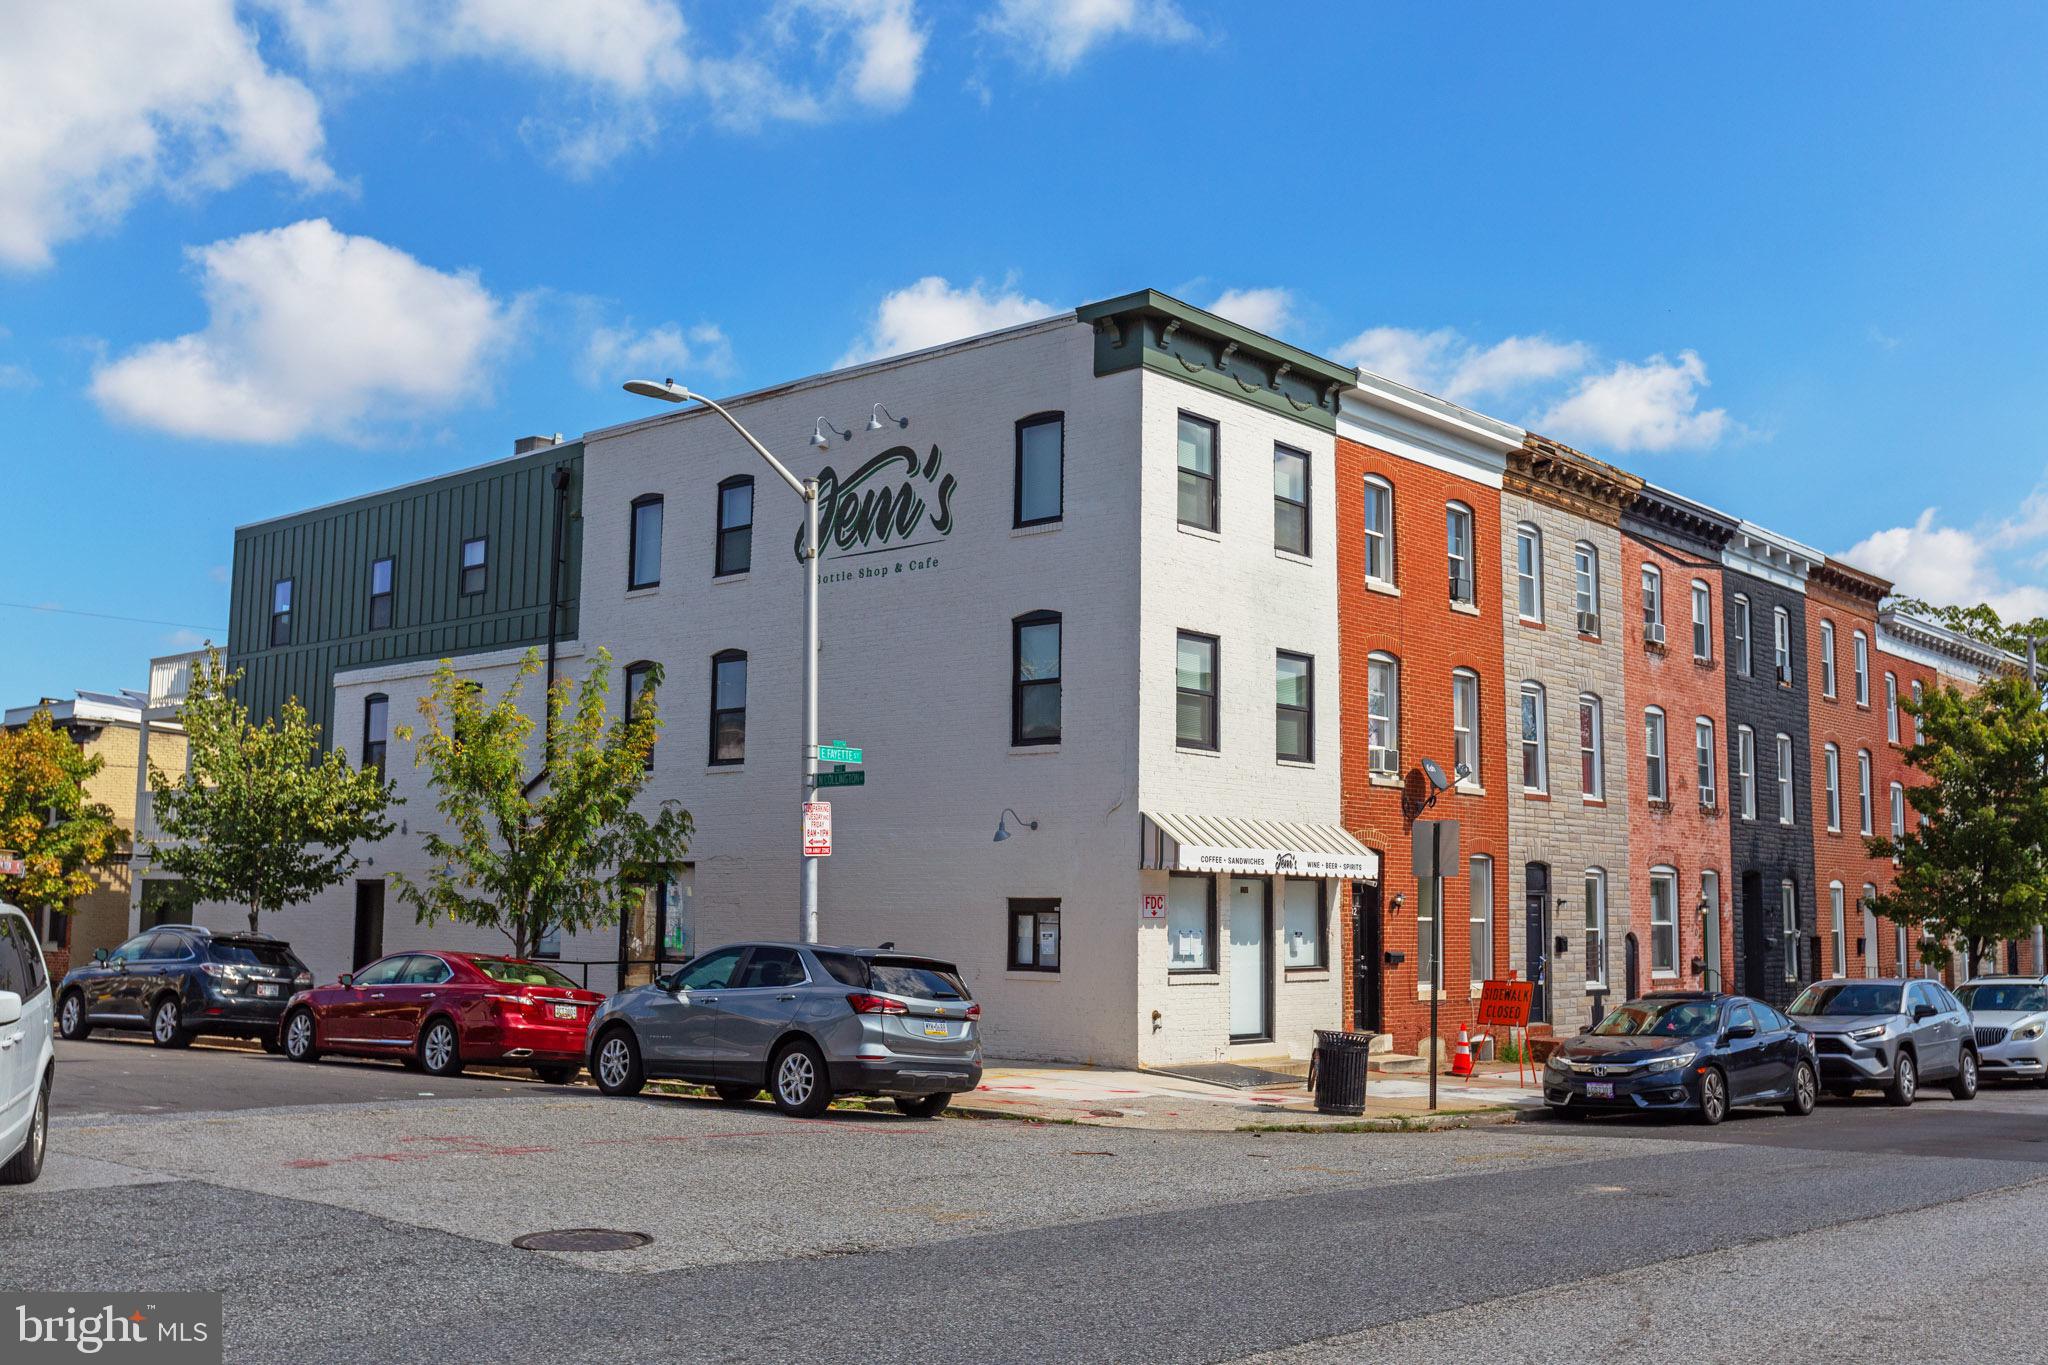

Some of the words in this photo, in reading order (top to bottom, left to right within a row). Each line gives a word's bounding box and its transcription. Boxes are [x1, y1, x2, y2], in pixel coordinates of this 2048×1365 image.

[858, 567, 888, 578] Shop
[894, 562, 903, 573] &
[909, 557, 939, 571] Cafe
[821, 748, 826, 759] E
[827, 748, 853, 761] FAYETTE
[1200, 855, 1223, 864] COFFEE
[1227, 857, 1265, 866] SANDWICHES
[1307, 861, 1320, 869] WINE
[1325, 862, 1338, 870] BEER
[1343, 863, 1362, 871] SPIRITS
[1145, 896, 1164, 910] FDC
[1483, 988, 1530, 1002] SIDEWALK
[1486, 1005, 1521, 1019] CLOSED
